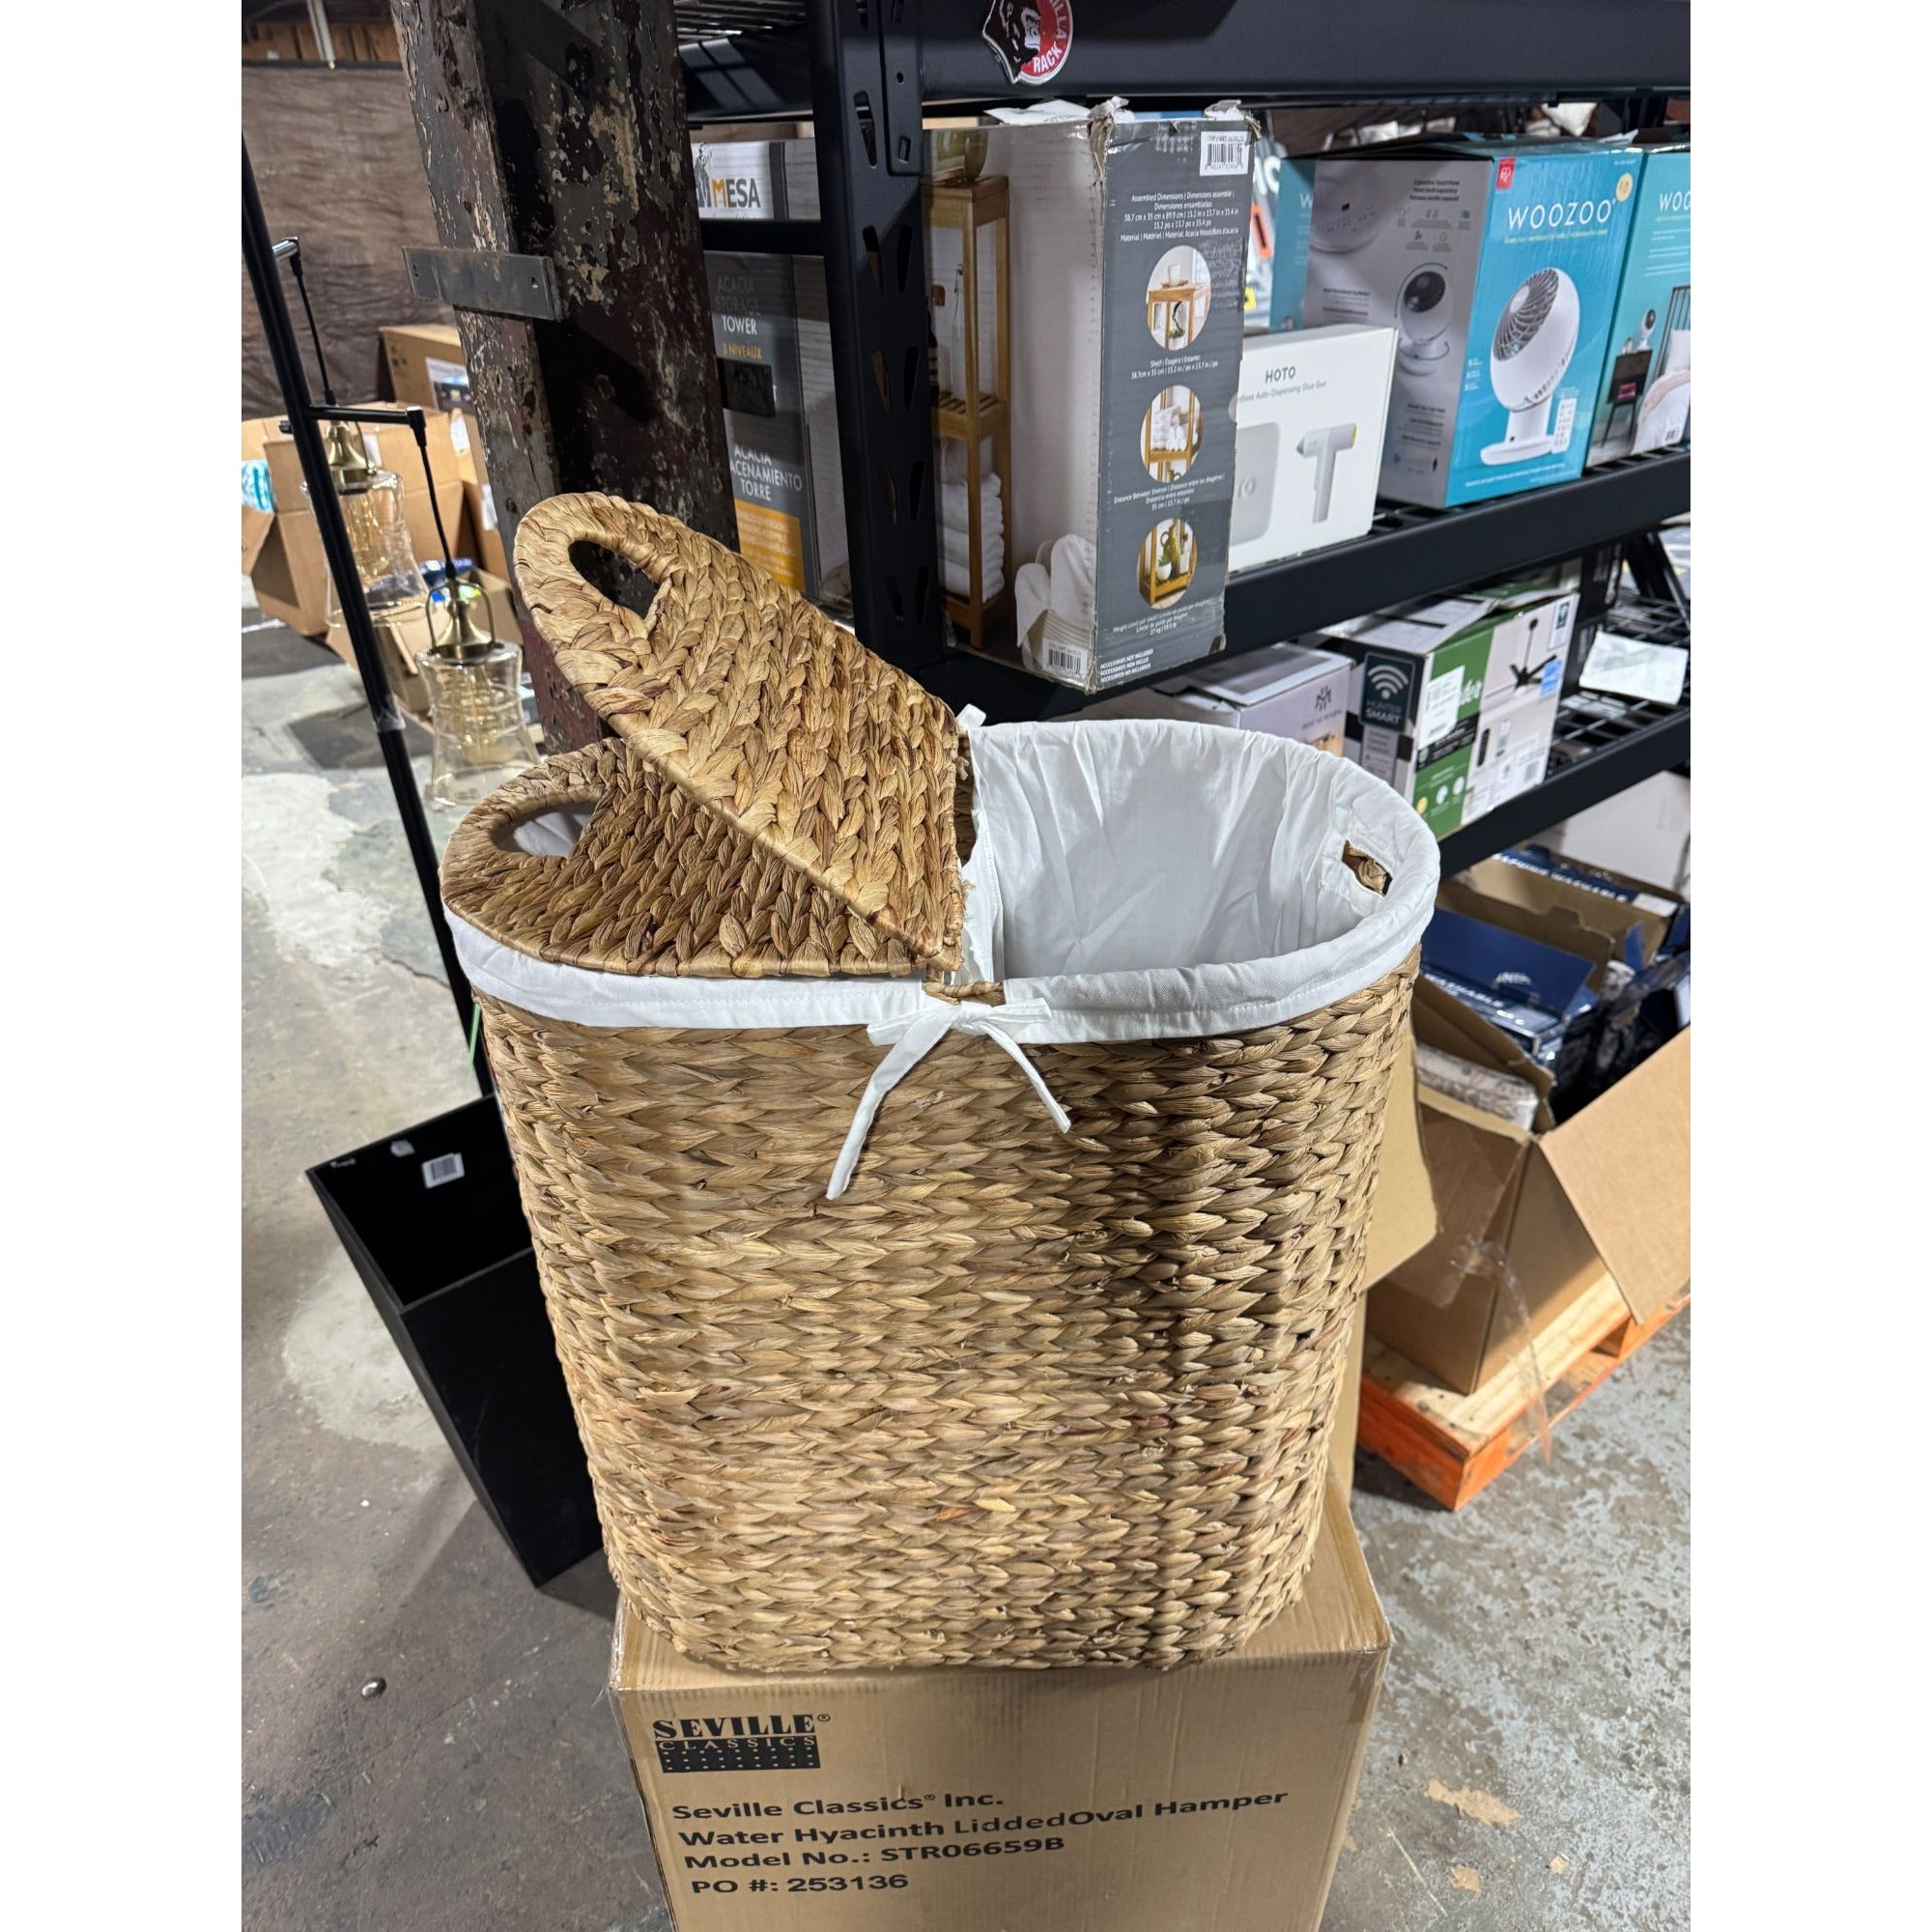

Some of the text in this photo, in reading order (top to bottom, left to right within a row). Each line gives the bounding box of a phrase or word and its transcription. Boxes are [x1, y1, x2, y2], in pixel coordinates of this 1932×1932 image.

[1049, 0, 1067, 39] ILLA
[1033, 41, 1062, 73] RACK
[1508, 199, 1613, 231] WOOZOO
[721, 315, 757, 336] TOWER
[728, 344, 763, 360] NIVEAUX
[1264, 366, 1296, 384] HOTO
[740, 478, 772, 501] TORRE
[1365, 708, 1401, 724] SMART
[659, 1736, 815, 1750] CLASSICS
[672, 1802, 782, 1819] Seville
[944, 1793, 1004, 1808] Inc.
[678, 1832, 783, 1846] Water
[794, 1822, 945, 1844] Hyacinth
[1154, 1793, 1289, 1816] Hamper
[684, 1837, 1065, 1868] Model No.: STR06659B
[692, 1874, 909, 1893] PO #: 253136
